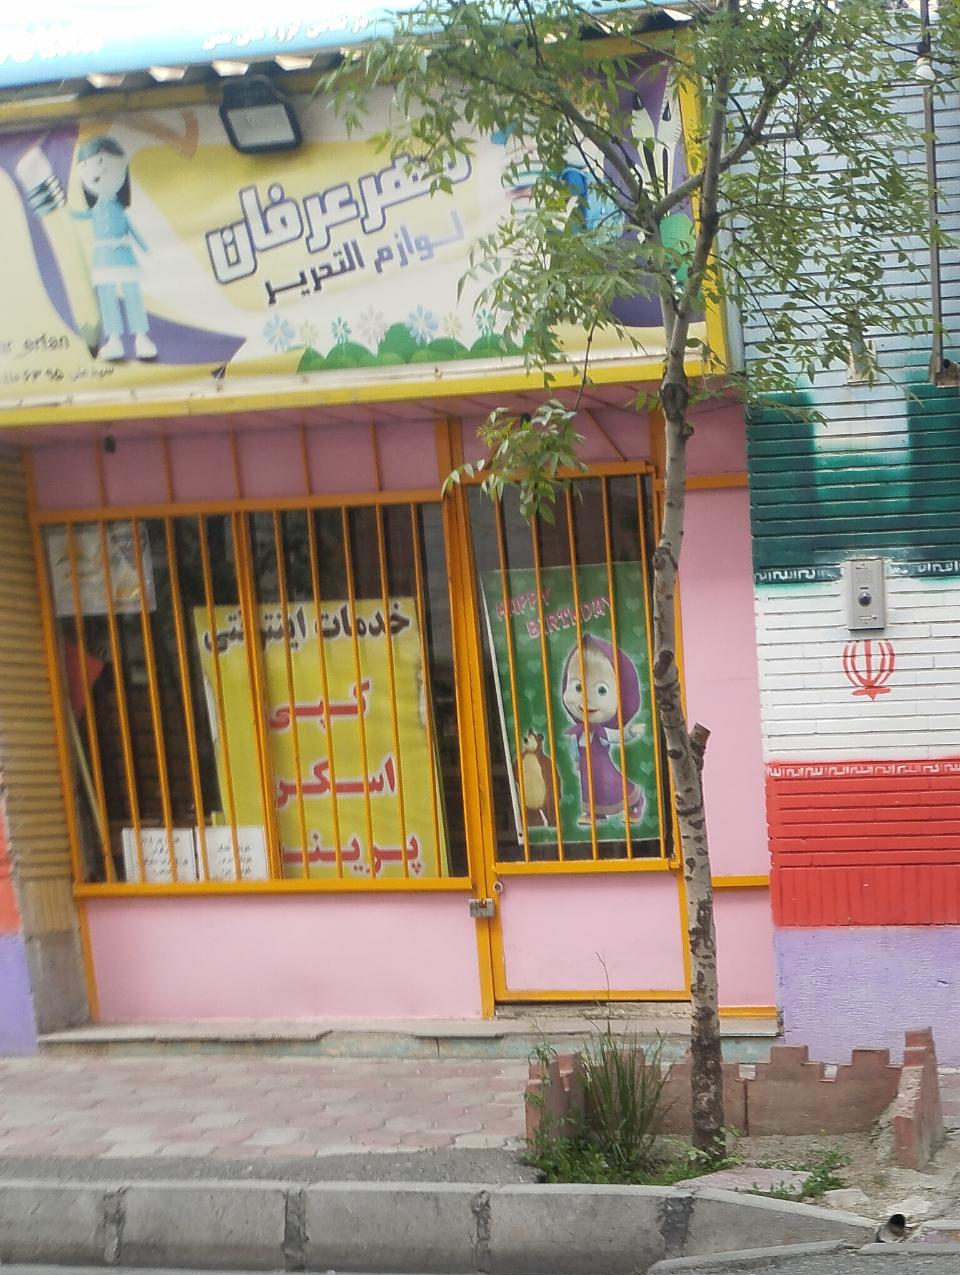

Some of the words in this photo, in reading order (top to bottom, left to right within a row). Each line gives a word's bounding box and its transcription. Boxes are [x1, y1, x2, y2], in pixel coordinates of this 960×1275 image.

[205, 182, 362, 285] عرفان
[373, 208, 466, 275] لوازم
[204, 605, 307, 653] اینترتی
[526, 595, 611, 639] BRTHDAY
